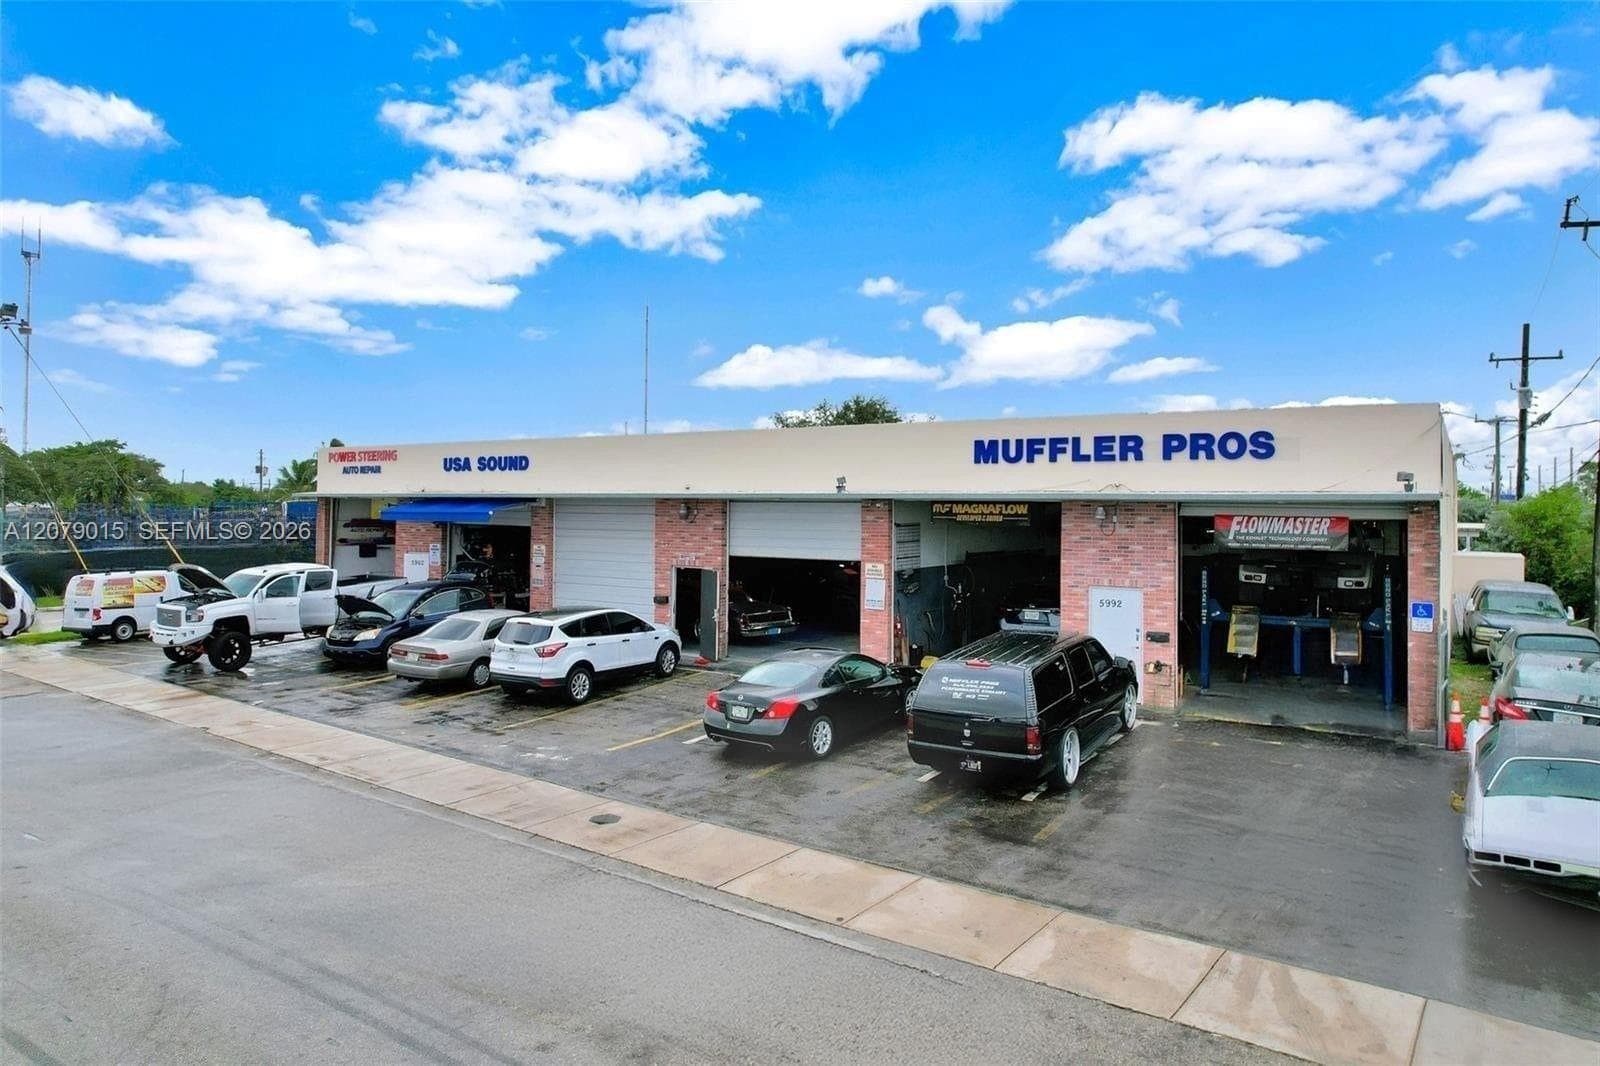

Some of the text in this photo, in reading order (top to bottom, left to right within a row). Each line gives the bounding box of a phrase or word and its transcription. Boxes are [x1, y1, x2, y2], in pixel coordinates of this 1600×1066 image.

[973, 430, 1276, 465] MUFFLER PROS
[328, 449, 398, 463] POWER STEERING
[443, 455, 530, 472] USA SOUND
[342, 464, 382, 475] AUTO REPAIR
[952, 503, 1029, 515] MAGNAFLOW
[1228, 515, 1331, 540] FLOWMASTER
